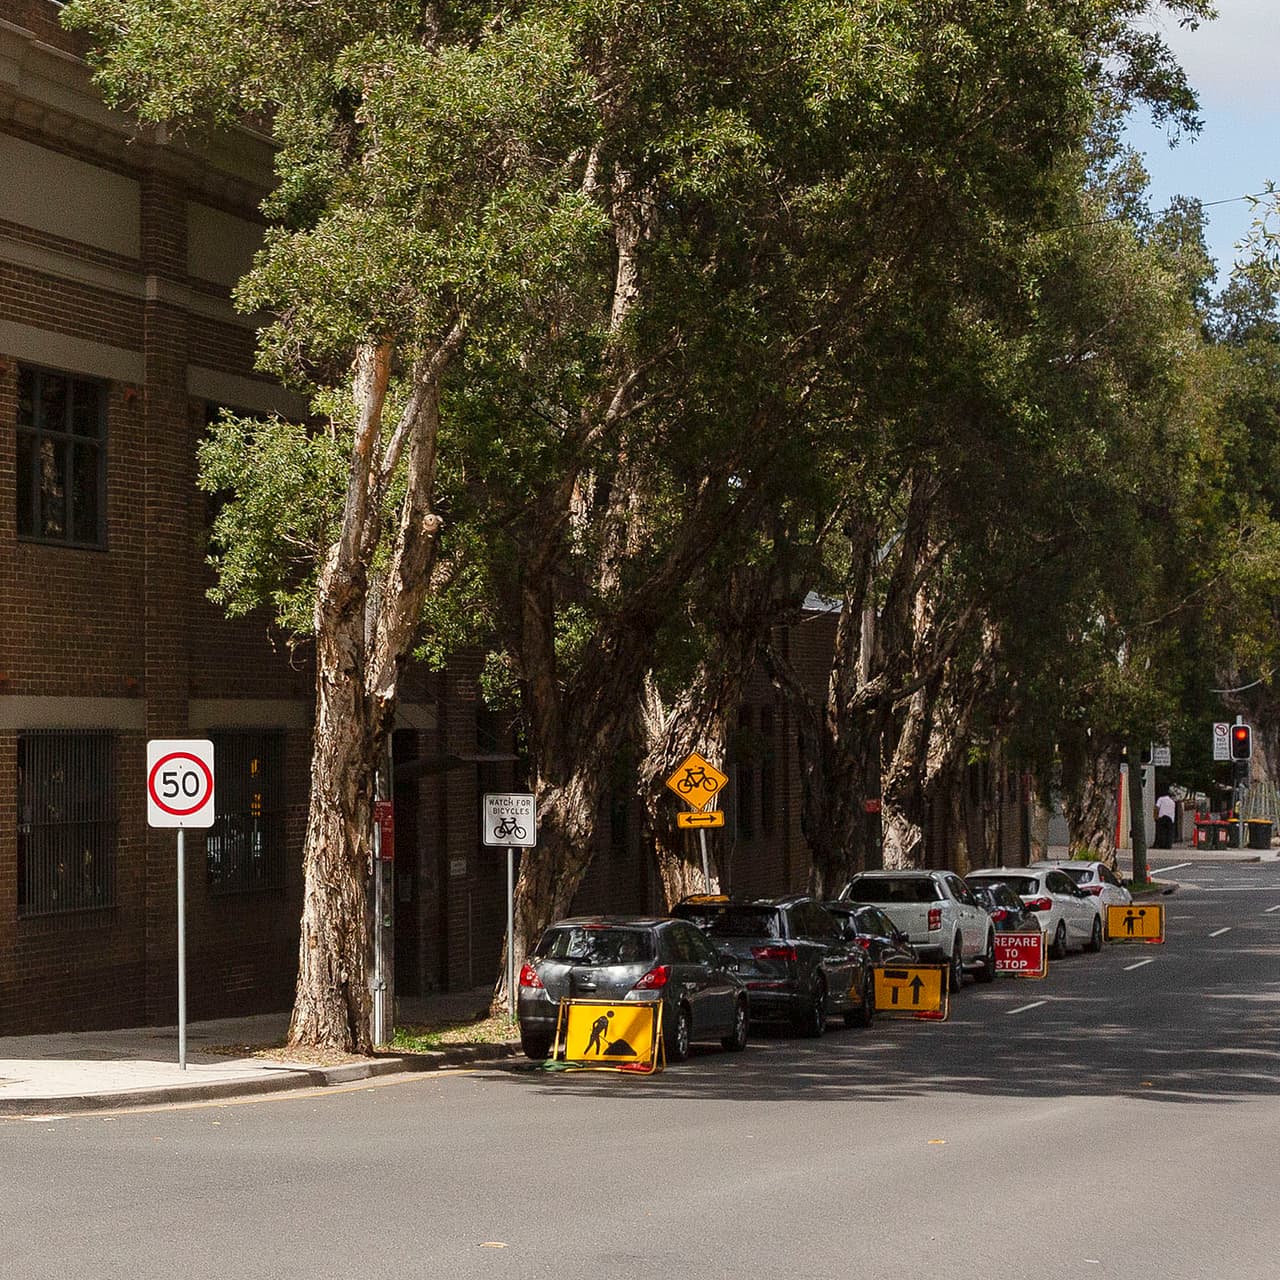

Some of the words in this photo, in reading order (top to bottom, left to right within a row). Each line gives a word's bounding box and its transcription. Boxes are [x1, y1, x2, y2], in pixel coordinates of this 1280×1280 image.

[162, 771, 200, 798] 50
[493, 807, 530, 815] BICYCLES
[994, 937, 1038, 947] REPARE
[1005, 948, 1019, 958] TO
[995, 960, 1028, 969] STOP
